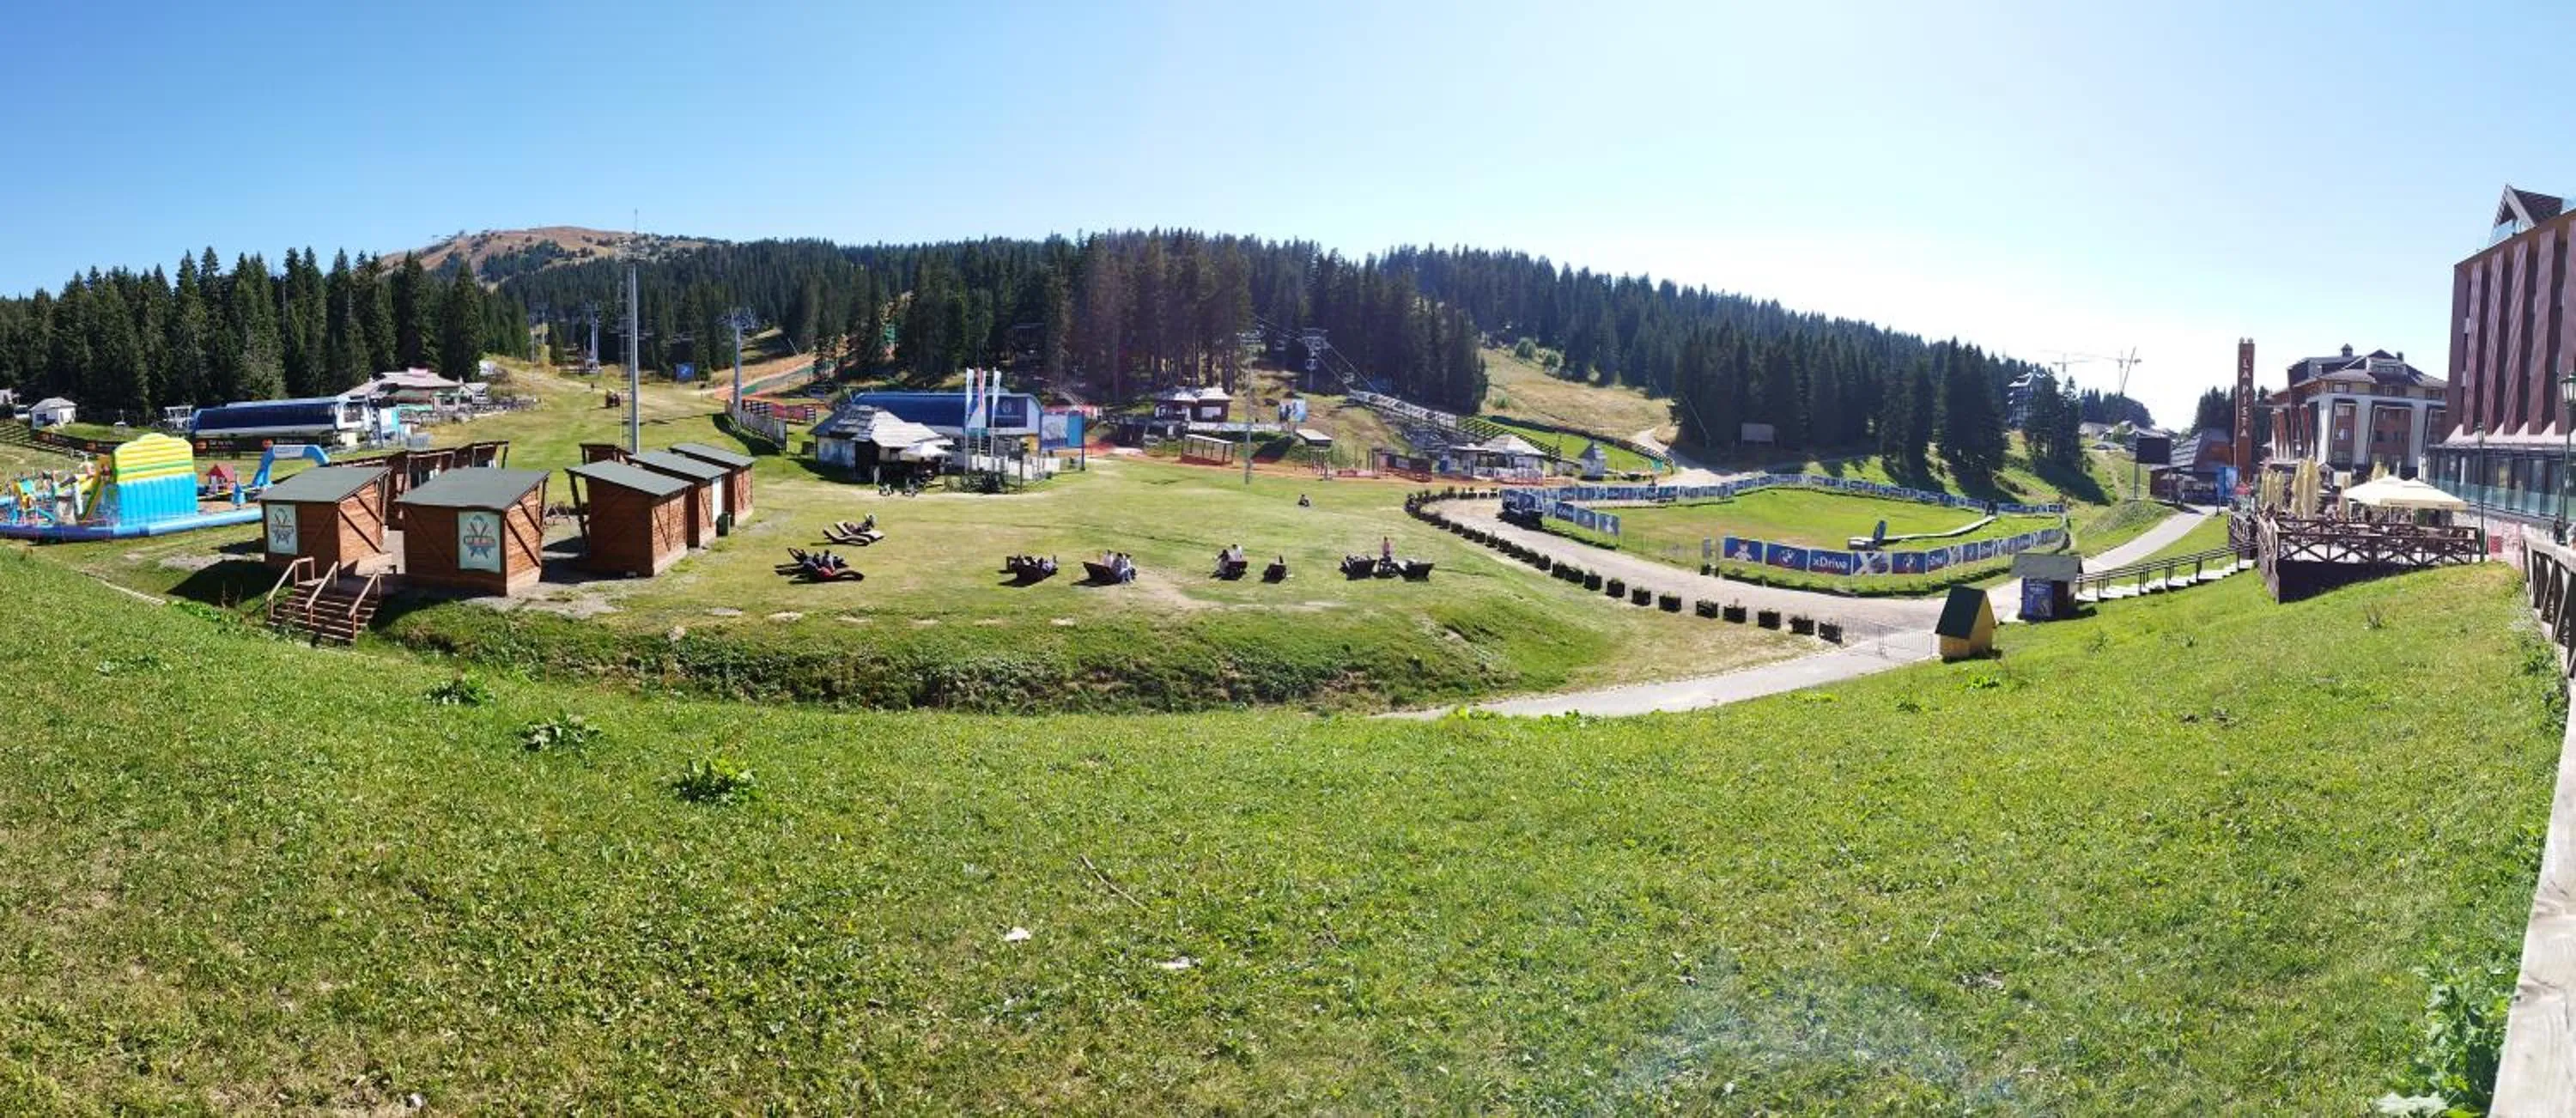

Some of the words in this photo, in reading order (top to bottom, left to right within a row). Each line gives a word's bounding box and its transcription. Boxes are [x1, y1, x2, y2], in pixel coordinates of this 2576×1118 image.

[2242, 357, 2251, 379] LA
[2240, 384, 2250, 438] PISTA
[1813, 556, 1849, 570] xDrive
